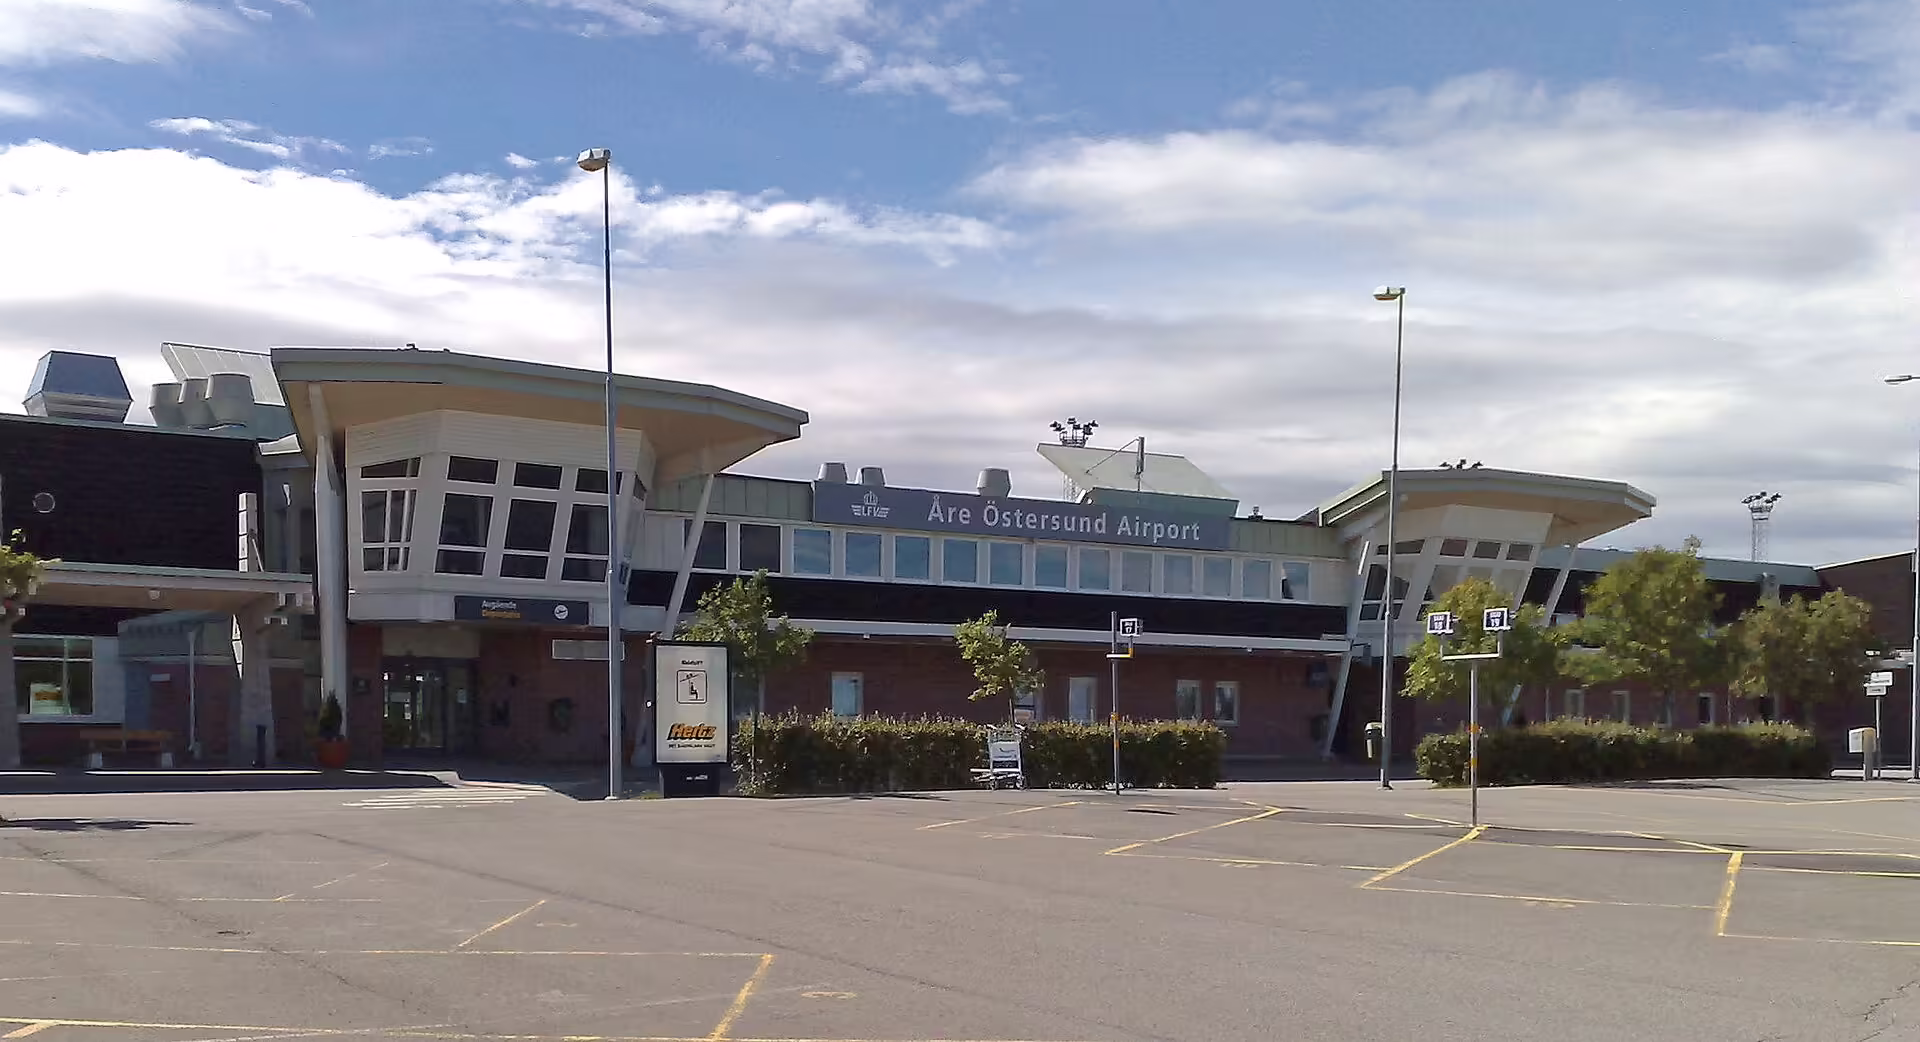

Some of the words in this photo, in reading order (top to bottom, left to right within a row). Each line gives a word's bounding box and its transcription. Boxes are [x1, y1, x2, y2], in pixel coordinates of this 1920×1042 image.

[927, 494, 971, 523] Åre
[983, 500, 1107, 534] Östersund
[1117, 514, 1200, 543] Airport
[666, 722, 717, 740] Hertz
